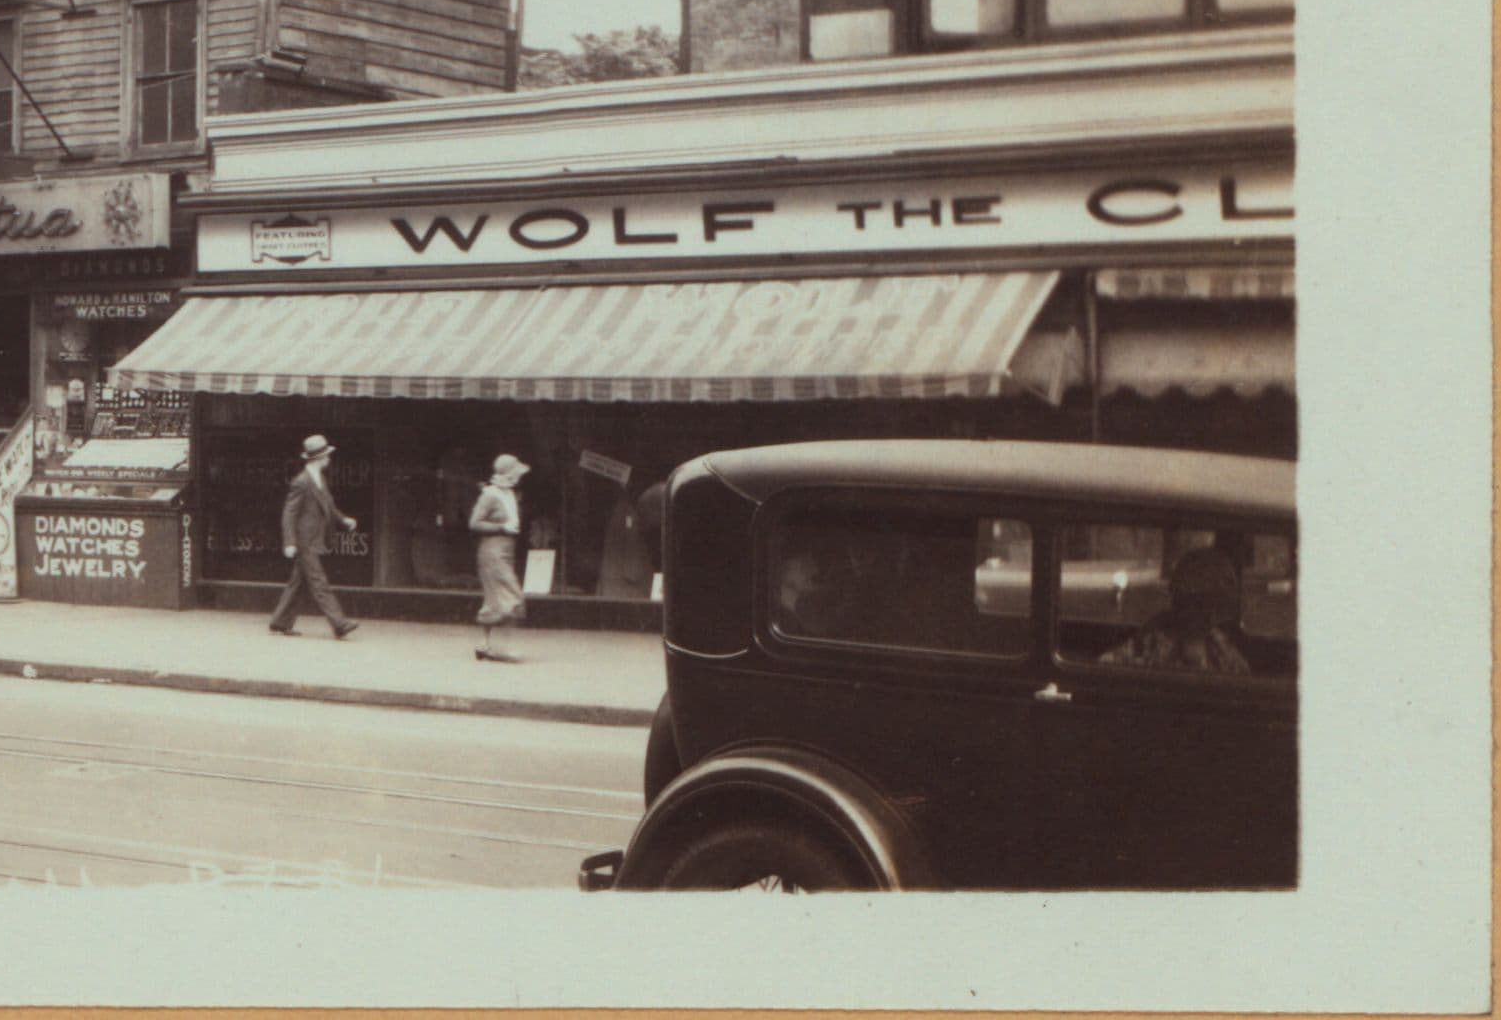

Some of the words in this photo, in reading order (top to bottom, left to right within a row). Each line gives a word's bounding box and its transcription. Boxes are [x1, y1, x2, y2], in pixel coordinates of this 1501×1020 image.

[390, 201, 776, 253] WOLF
[837, 194, 1002, 230] THE
[1086, 177, 1295, 226] CL
[255, 229, 325, 240] FEATURING
[59, 256, 165, 277] DIAMONDS
[75, 304, 148, 319] WATCHES
[117, 468, 156, 478] SPECIALS
[34, 515, 146, 538] DIAMONDS
[35, 535, 141, 557] WATCHES
[181, 513, 193, 588] DIAMONDS
[34, 553, 148, 578] JEWELRY
